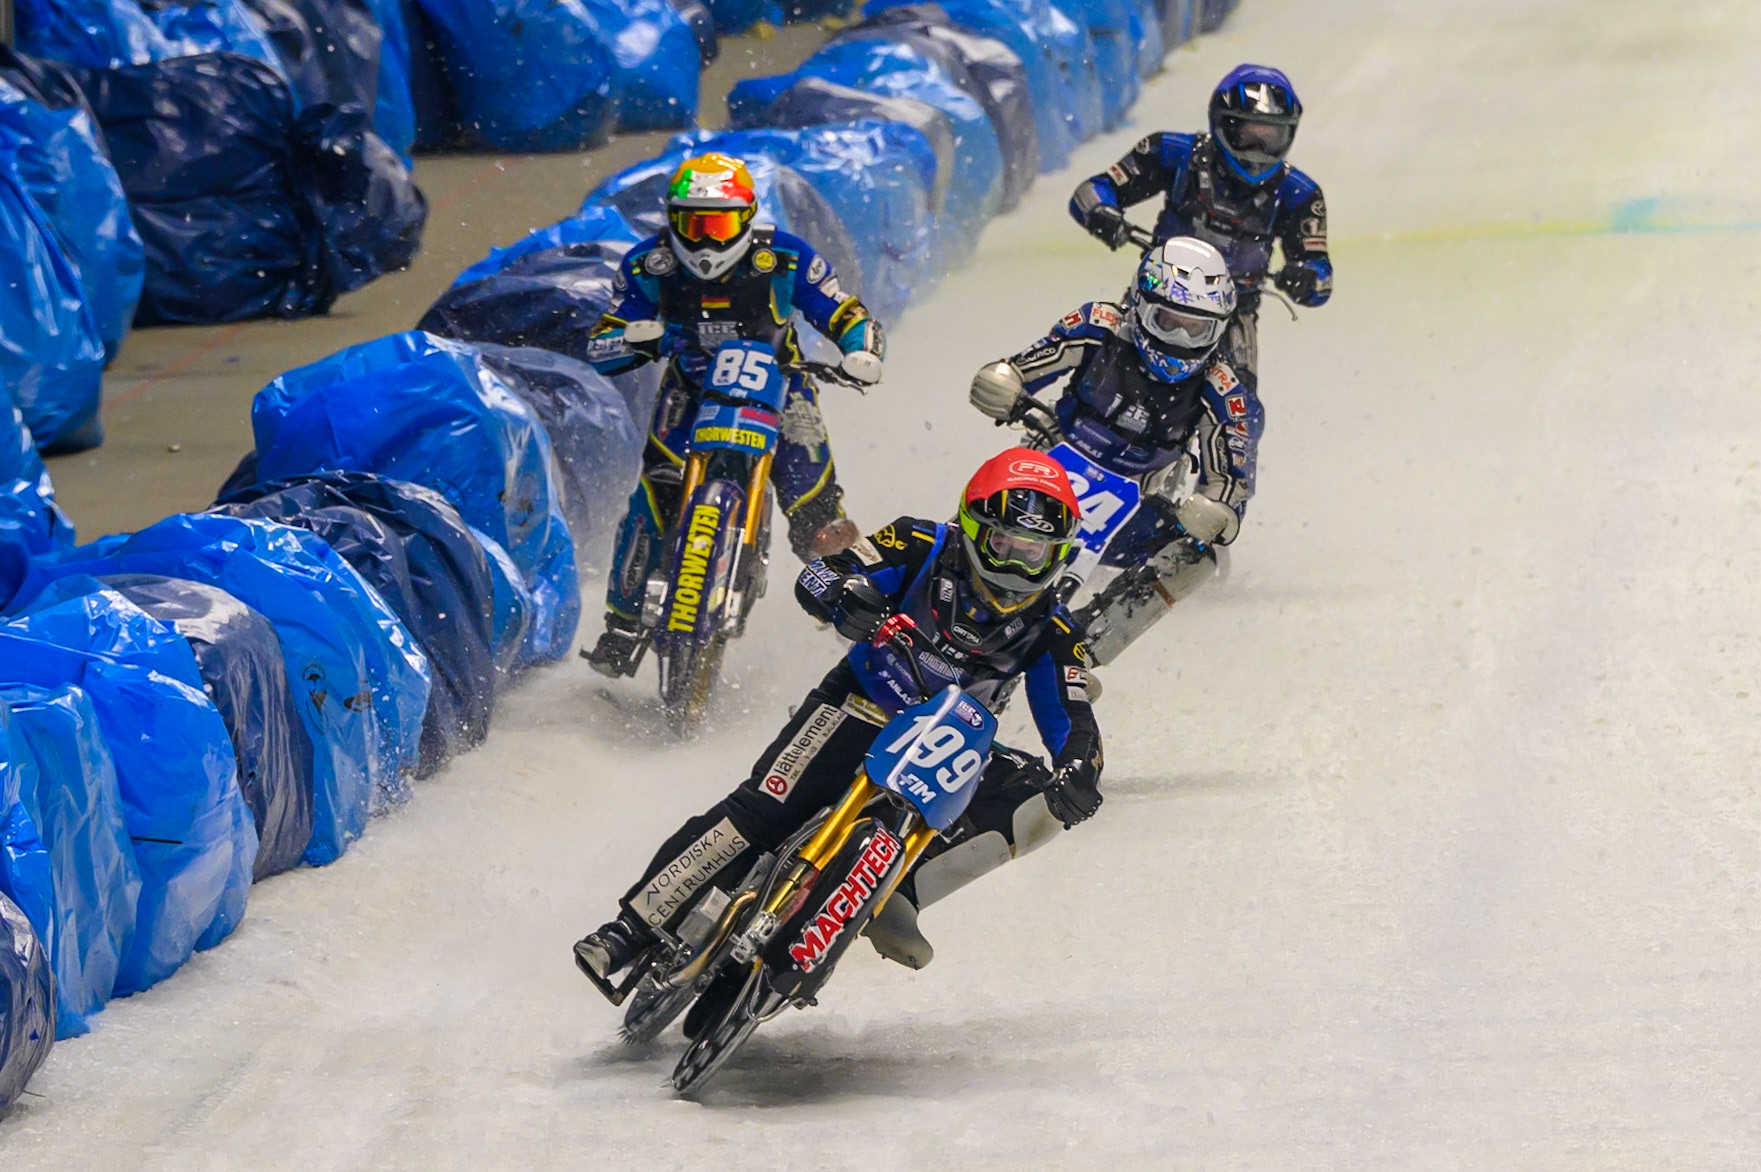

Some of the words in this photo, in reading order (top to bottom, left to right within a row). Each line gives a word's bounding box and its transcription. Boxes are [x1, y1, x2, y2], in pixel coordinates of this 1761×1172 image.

[712, 348, 774, 392] 85
[667, 504, 721, 633] THORWESTEN
[772, 705, 839, 777] lättelement
[885, 714, 982, 794] 199
[897, 773, 938, 804] FIM
[645, 827, 725, 906] NORDISKA
[649, 835, 747, 927] CENTRUMHUS
[789, 826, 903, 973] MACHTECH
